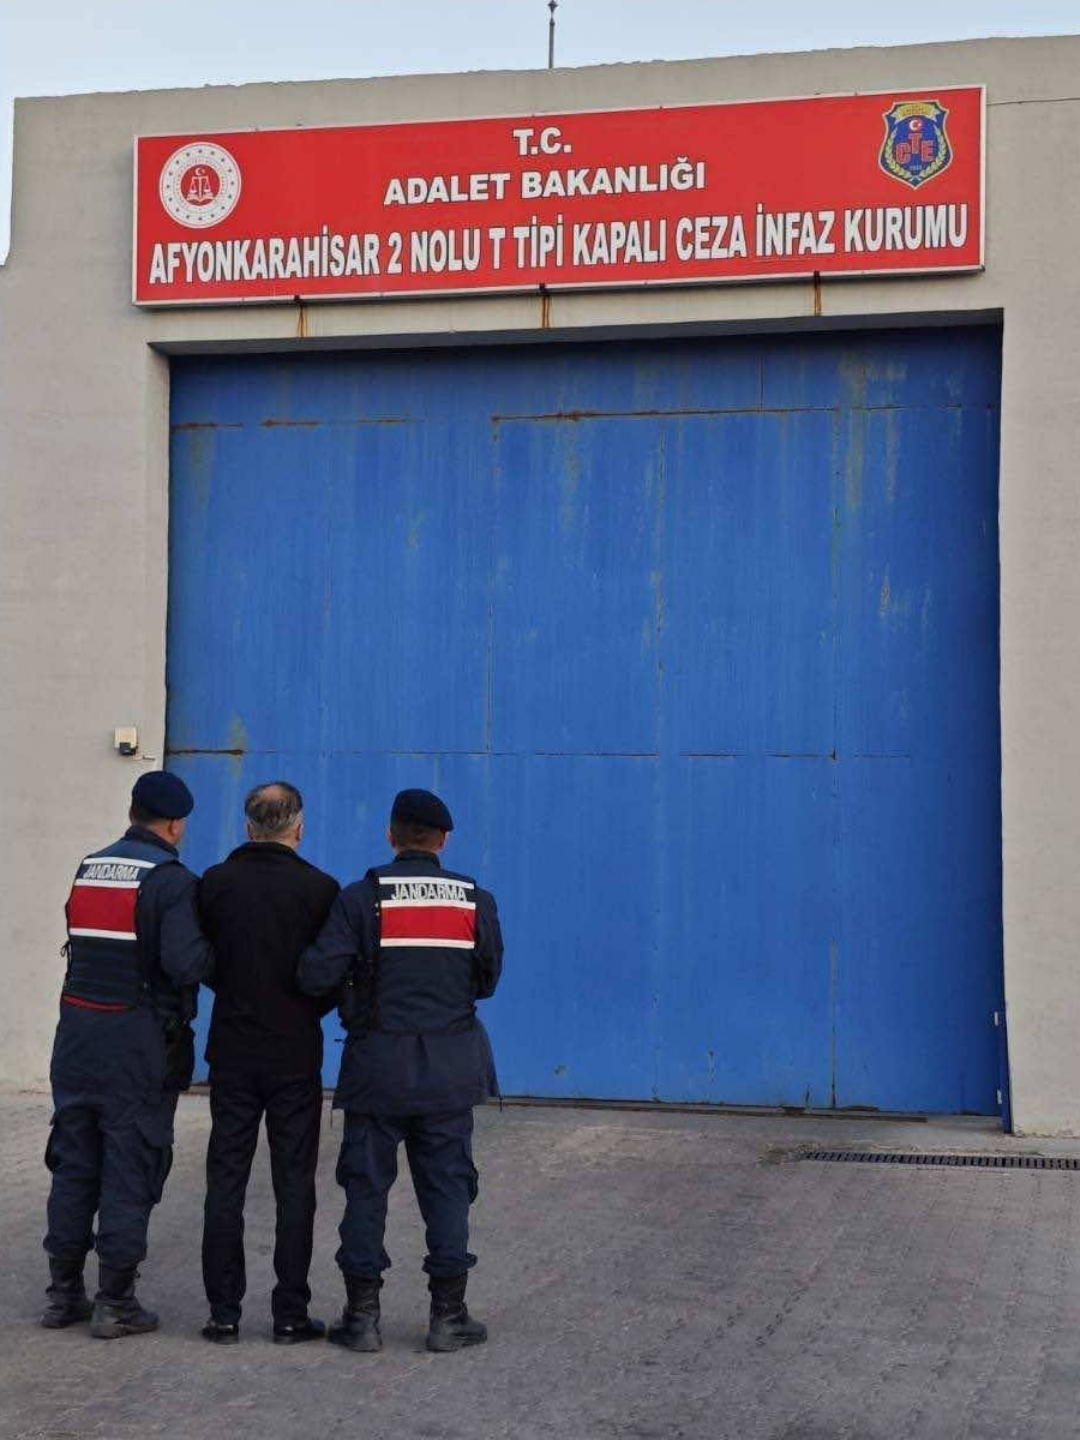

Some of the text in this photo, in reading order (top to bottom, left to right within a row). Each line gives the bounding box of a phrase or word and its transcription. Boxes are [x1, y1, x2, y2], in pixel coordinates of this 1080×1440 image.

[513, 127, 572, 156] T.C.
[383, 156, 705, 205] ADALET BAKANLIĞI
[149, 203, 967, 284] AFYONKARAHİSAR 2 NOLU T TİPİ KAPALI CEZA İNFAZ KURUMU
[83, 864, 140, 880] JANDARMA
[391, 883, 467, 902] JANDARMA
